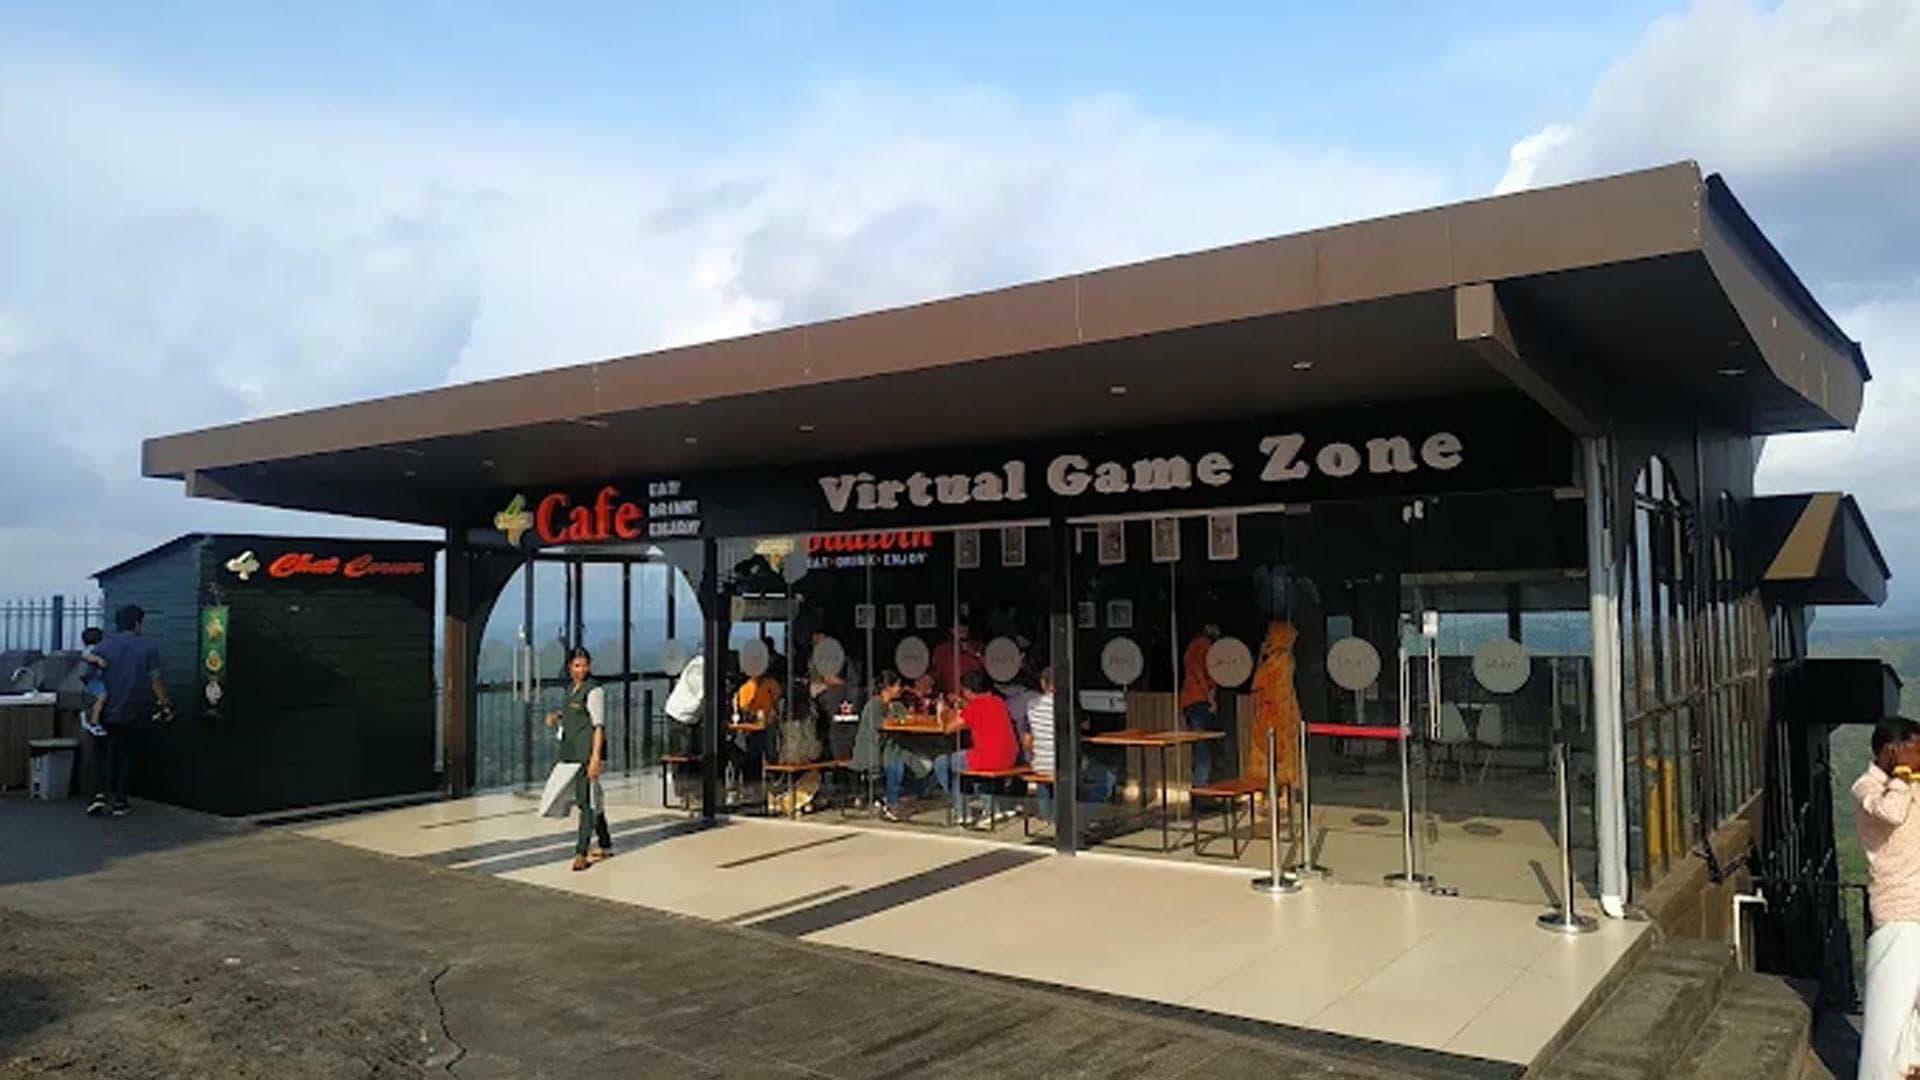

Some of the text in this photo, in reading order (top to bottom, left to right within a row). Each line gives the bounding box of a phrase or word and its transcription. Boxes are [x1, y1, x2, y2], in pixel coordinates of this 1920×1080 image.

[648, 479, 682, 497] EAT
[818, 432, 1463, 513] Virtual Game Zone
[536, 485, 643, 544] Cafe
